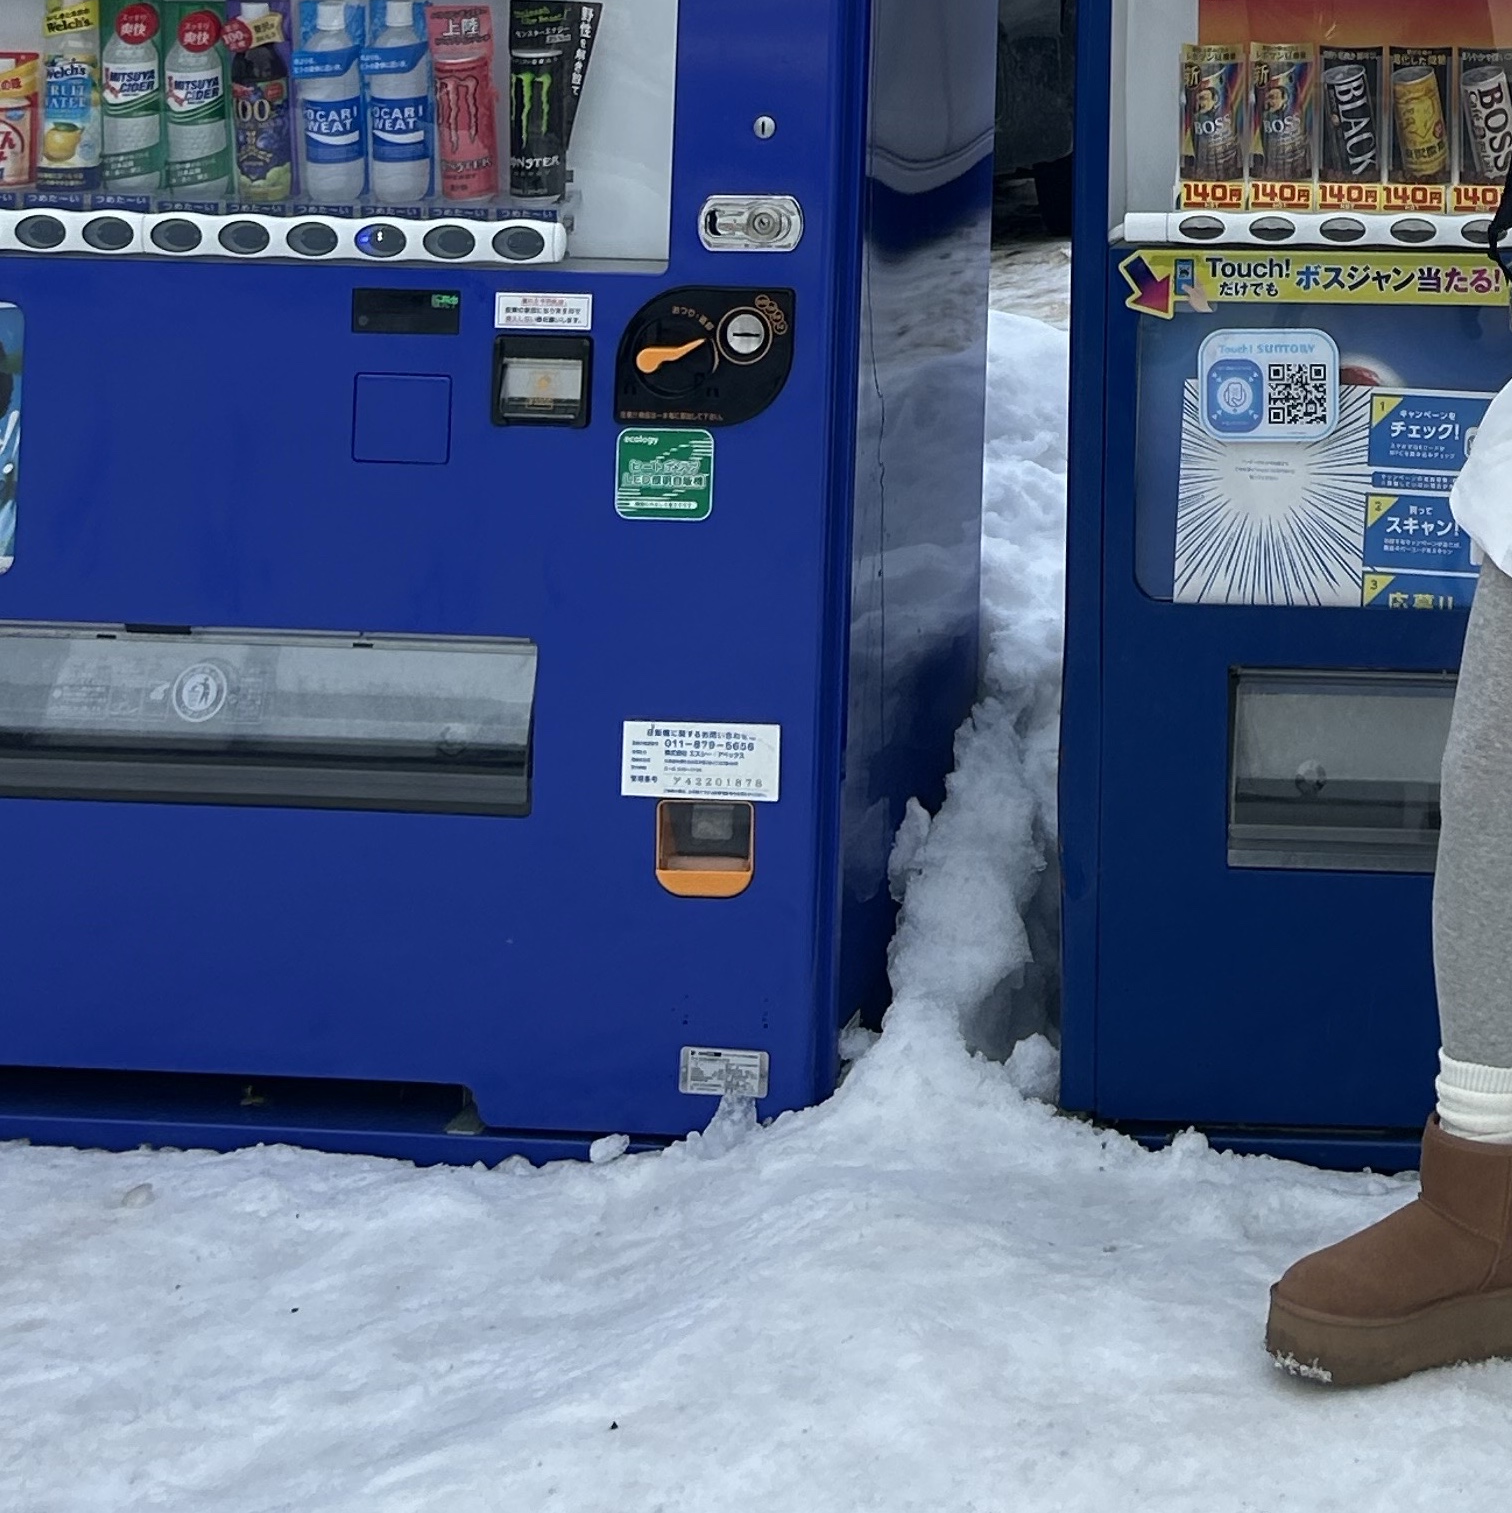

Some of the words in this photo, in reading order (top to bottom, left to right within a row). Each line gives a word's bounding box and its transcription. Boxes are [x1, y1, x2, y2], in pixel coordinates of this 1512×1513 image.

[1334, 76, 1378, 175] BLACK
[1479, 83, 1512, 171] BOSS
[1184, 184, 1242, 201] 140円
[1251, 184, 1309, 202] 140円
[1319, 185, 1377, 203] 140円
[1383, 186, 1442, 204] 140円
[1454, 187, 1499, 205] 140
[1206, 257, 1291, 279] Touch!
[1295, 263, 1501, 294] ボスジャン当たる!
[1219, 281, 1279, 297] だけでも
[1400, 410, 1456, 420] キャンペーンを
[1390, 422, 1460, 440] チェック!
[1386, 517, 1460, 536] スキャン!
[1370, 580, 1378, 590] 3
